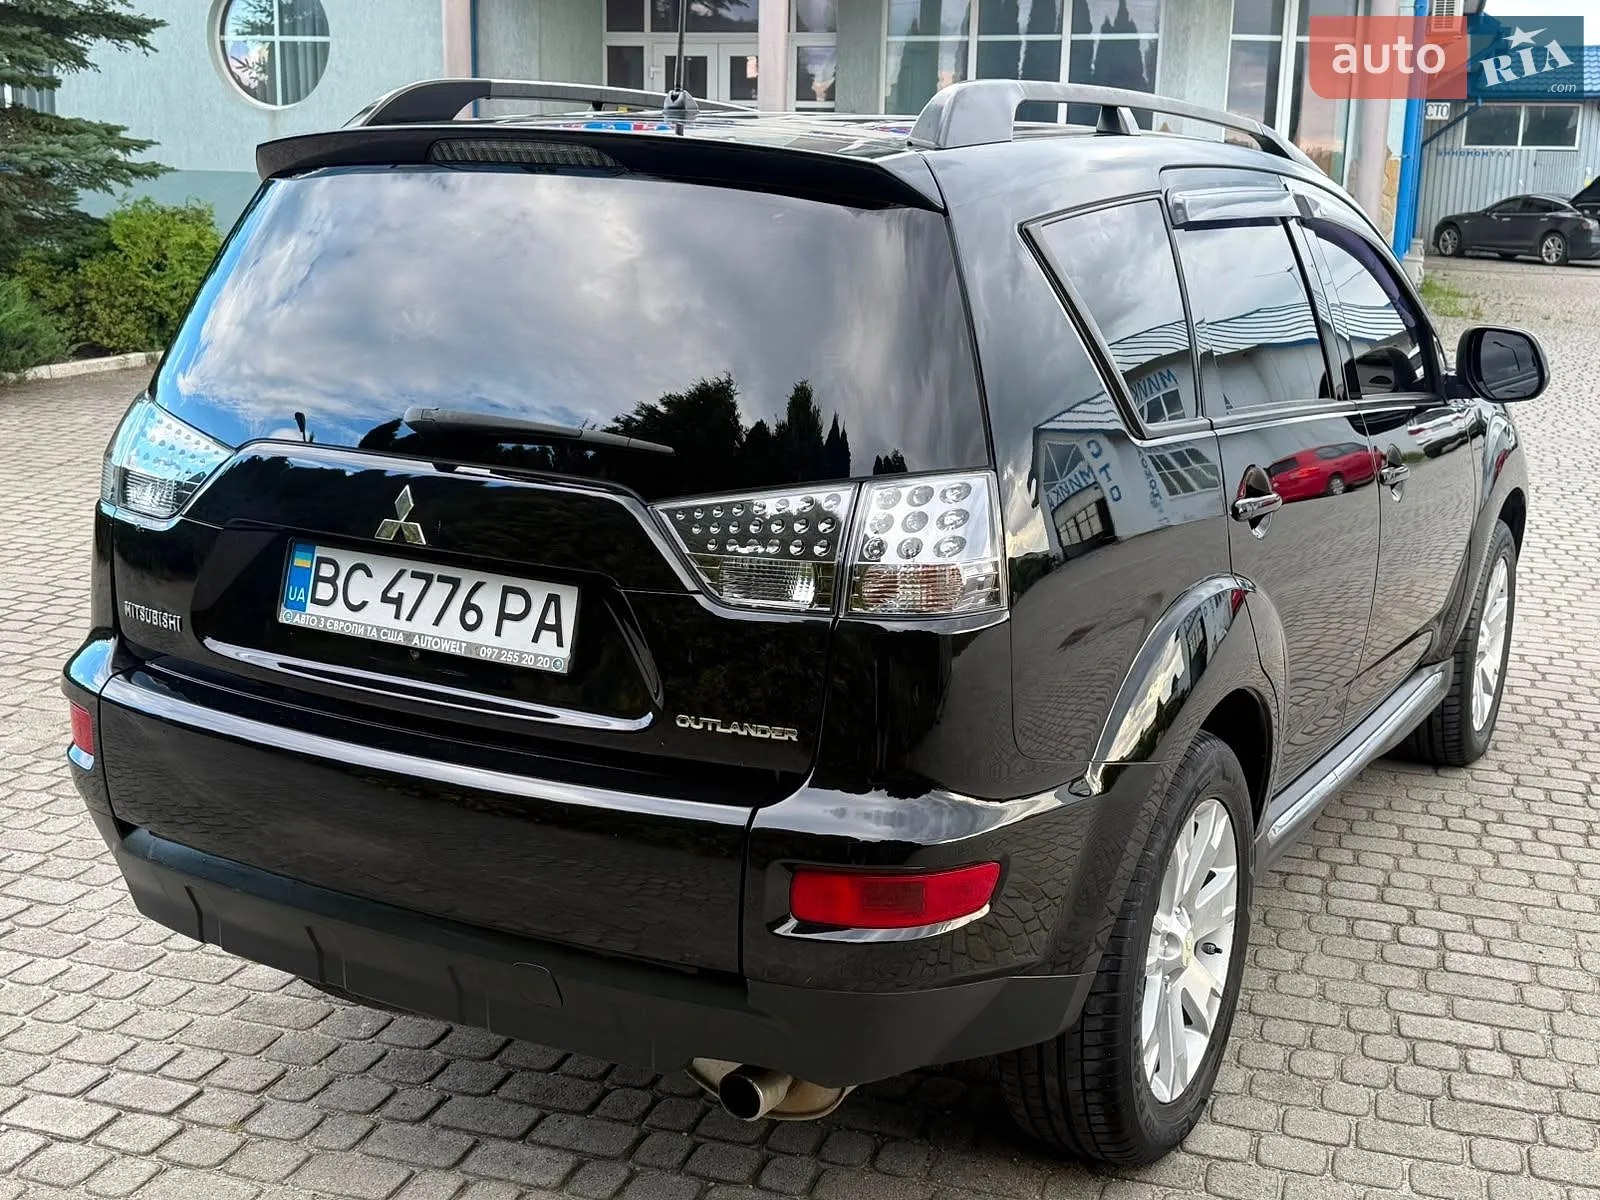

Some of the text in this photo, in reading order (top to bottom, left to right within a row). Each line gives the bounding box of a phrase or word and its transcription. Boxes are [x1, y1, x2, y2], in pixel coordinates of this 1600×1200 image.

[288, 585, 306, 603] UA
[309, 555, 565, 648] BC 4776 PA
[124, 600, 182, 633] MITSUBISHI
[292, 612, 318, 628] АВТО
[326, 618, 366, 637] ЄВРОПИ
[366, 625, 379, 640] ТА
[380, 627, 404, 644] США
[411, 633, 467, 655] AUTOWELT
[479, 645, 499, 660] 097
[500, 649, 519, 664] 255
[521, 653, 536, 667] 20
[536, 656, 550, 669] 20
[675, 714, 799, 742] OUTLANDER
